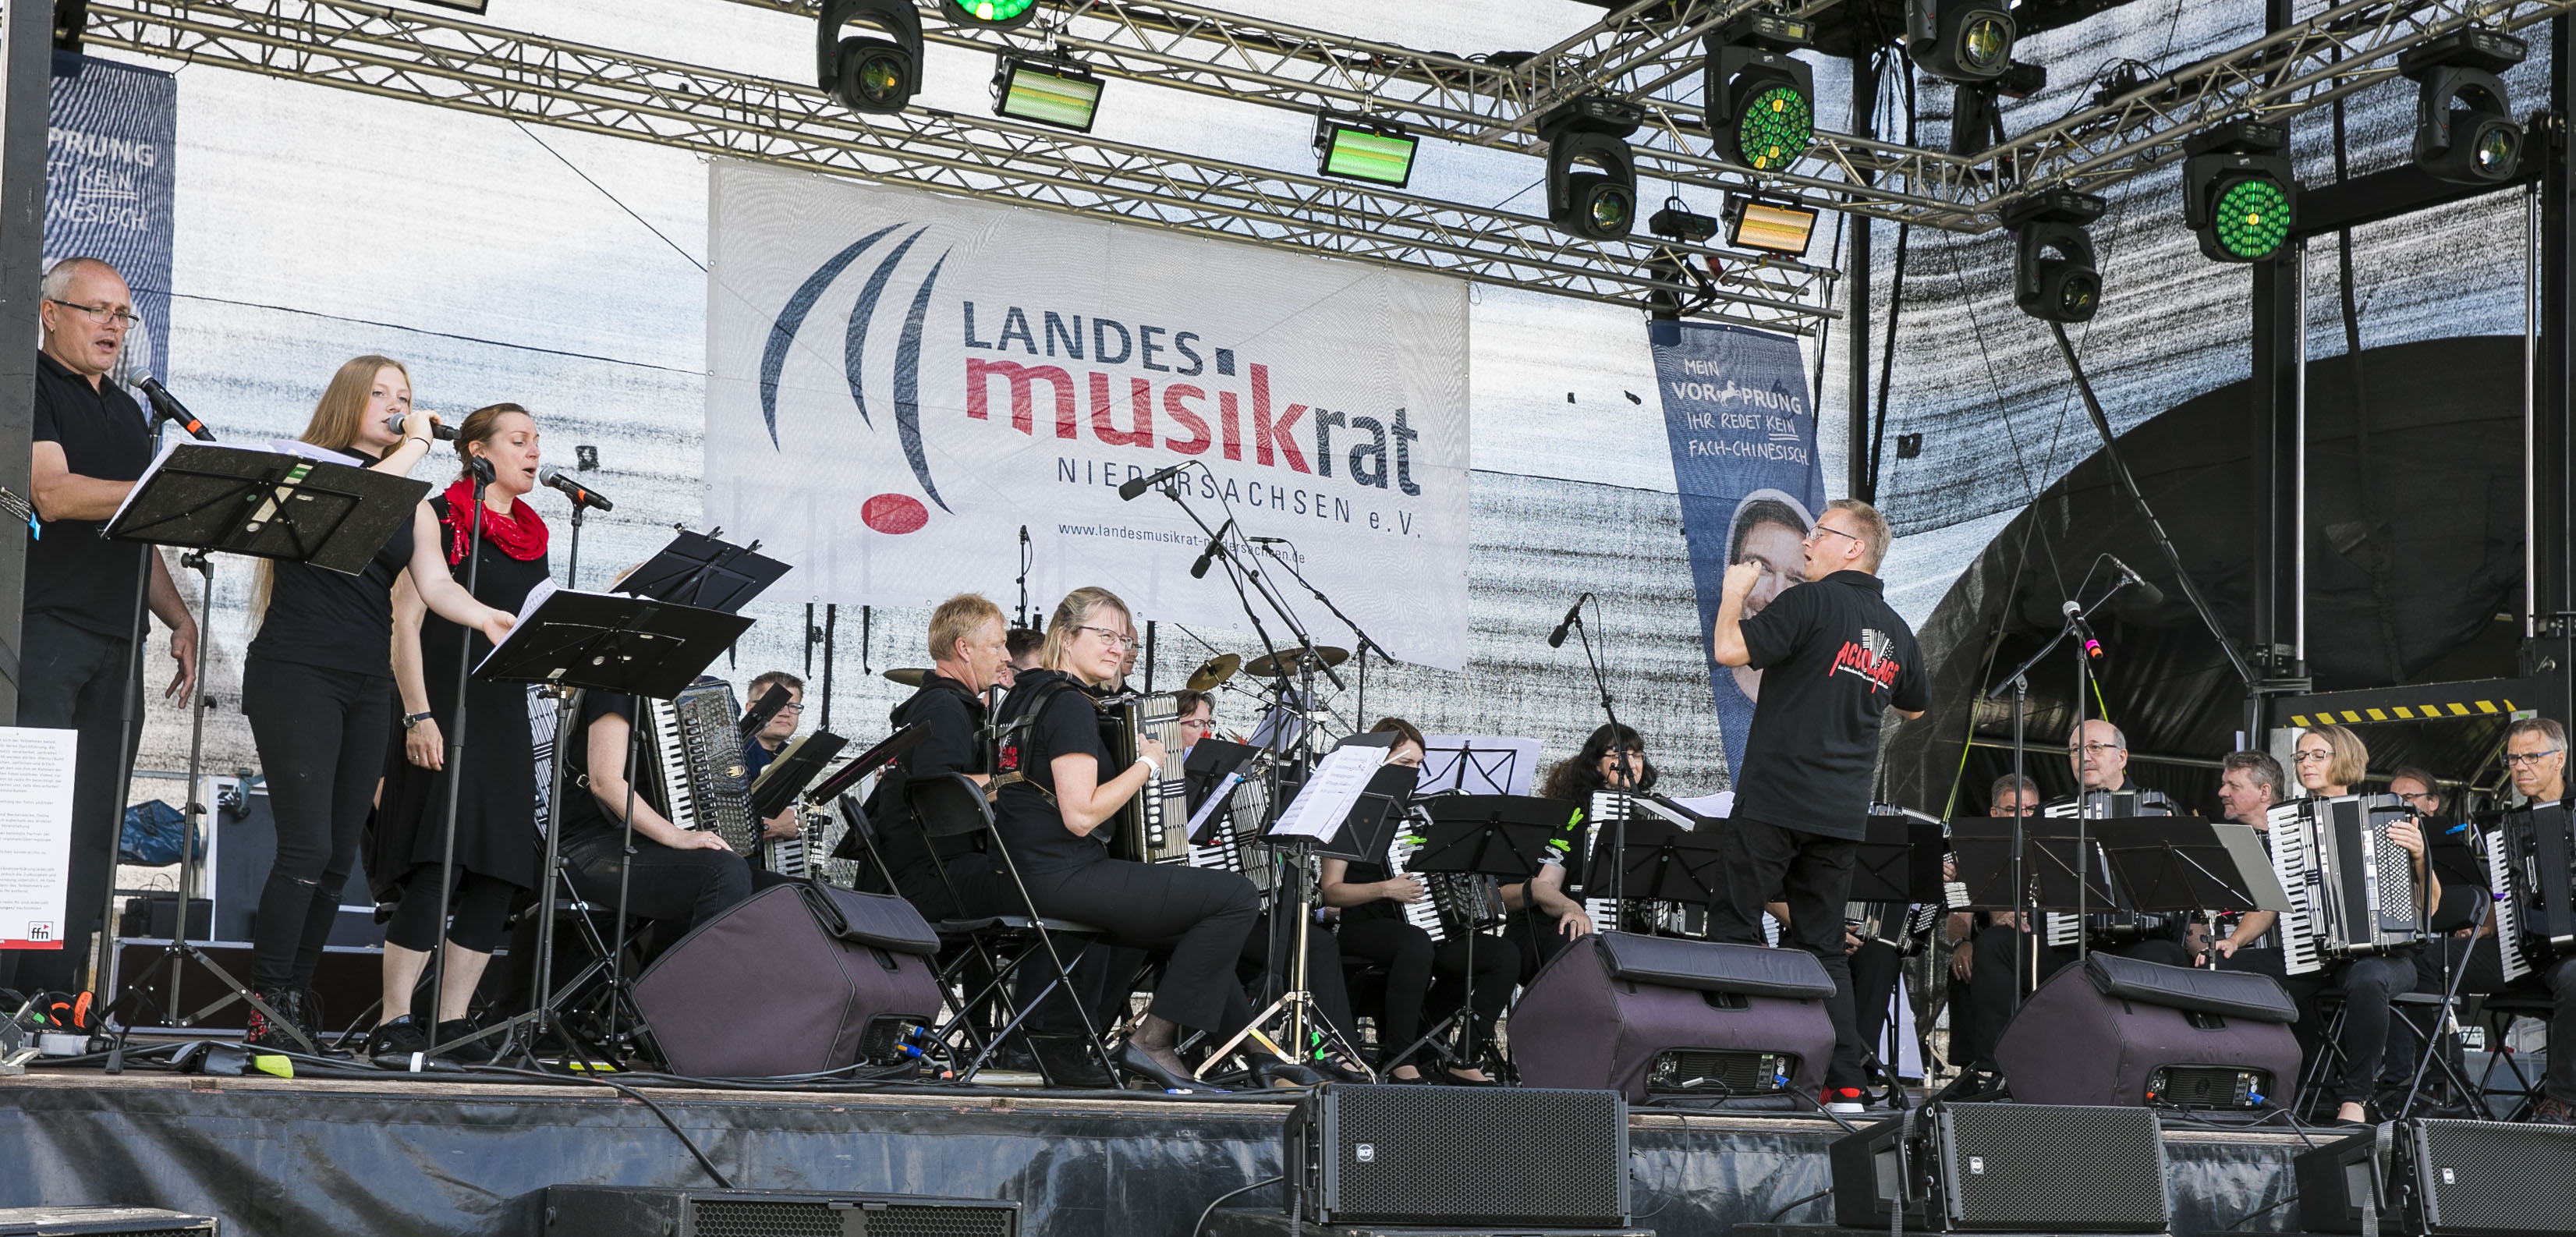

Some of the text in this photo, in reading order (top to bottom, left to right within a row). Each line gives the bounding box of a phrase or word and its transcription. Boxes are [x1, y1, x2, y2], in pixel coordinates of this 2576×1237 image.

[79, 165, 132, 190] KEIN
[963, 301, 1203, 377] LANDES
[1684, 358, 1720, 377] MEIN
[1686, 412, 1795, 434] IHR REDET KEIN
[31, 927, 49, 940] ffn
